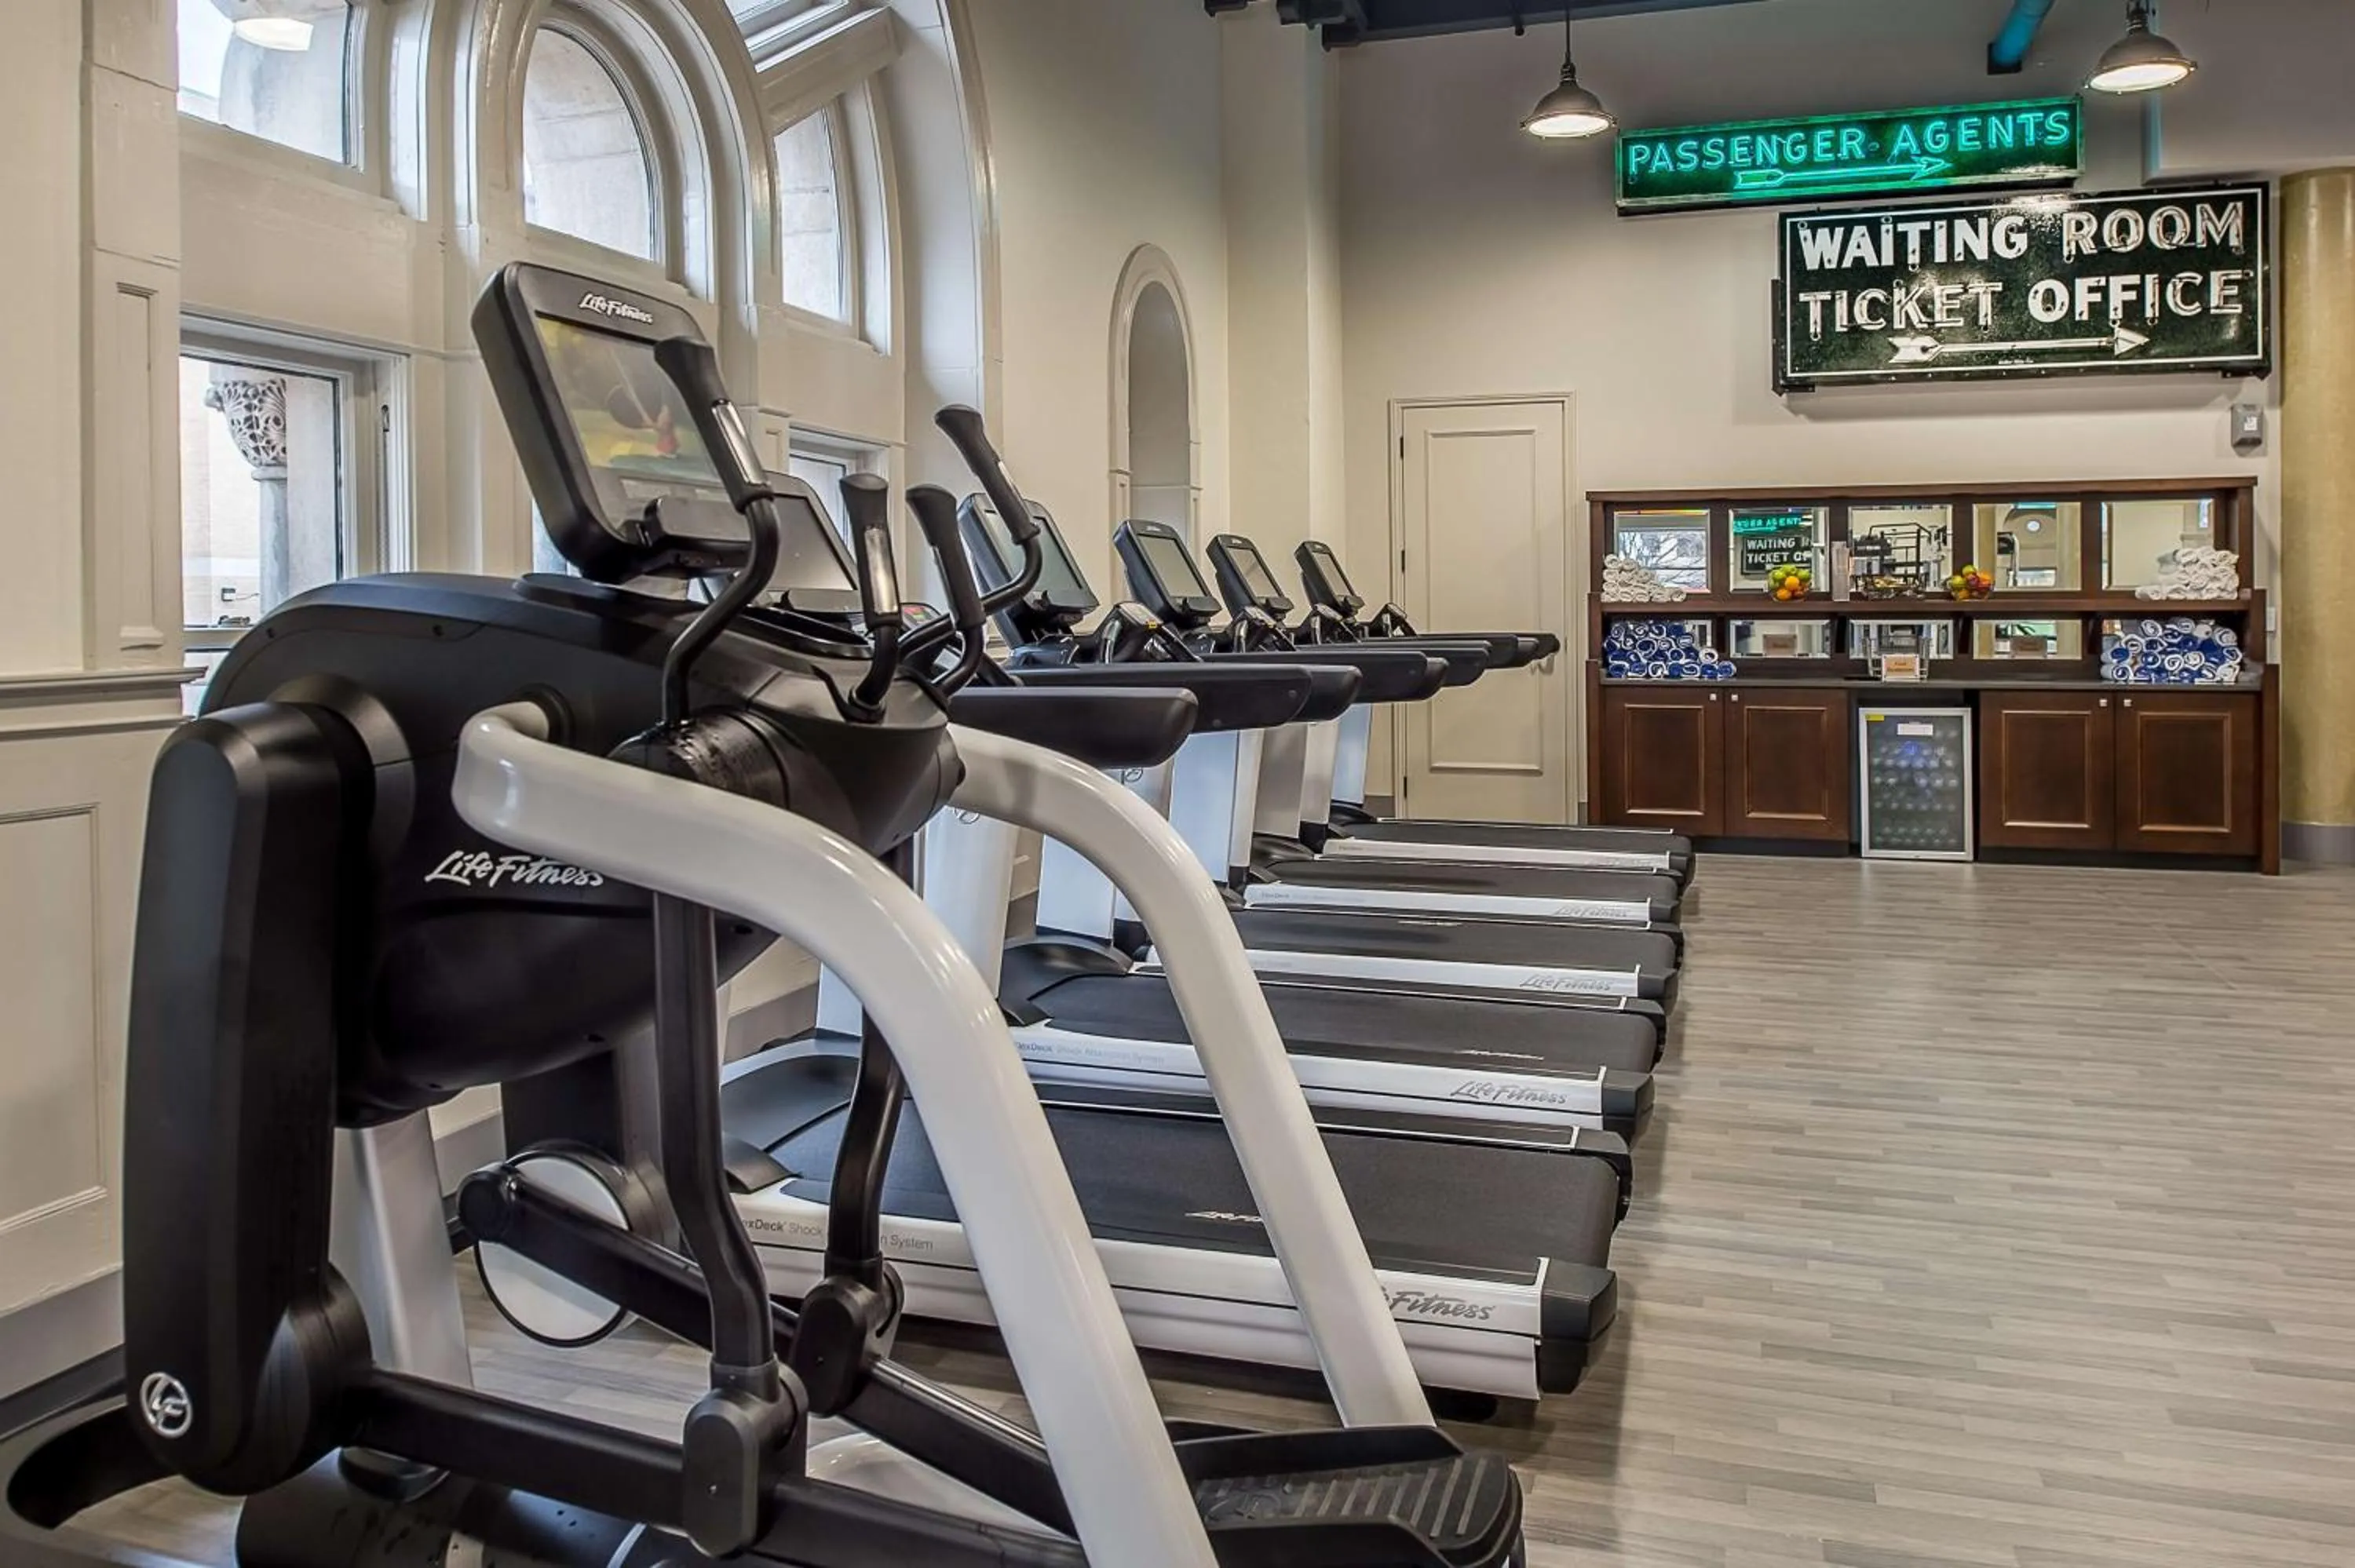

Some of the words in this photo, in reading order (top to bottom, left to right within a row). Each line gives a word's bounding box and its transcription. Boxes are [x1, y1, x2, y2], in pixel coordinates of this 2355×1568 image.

[1628, 127, 1866, 176] PASSENGER
[1892, 110, 2071, 155] AGENTS
[1799, 217, 2028, 270] WAITING
[2062, 201, 2244, 256] ROOM
[1799, 282, 2003, 334] TICKET
[2028, 269, 2244, 323] OFFICE
[1747, 537, 1795, 549] WAITING
[1747, 552, 1789, 563] TICKET
[890, 1234, 934, 1250] System
